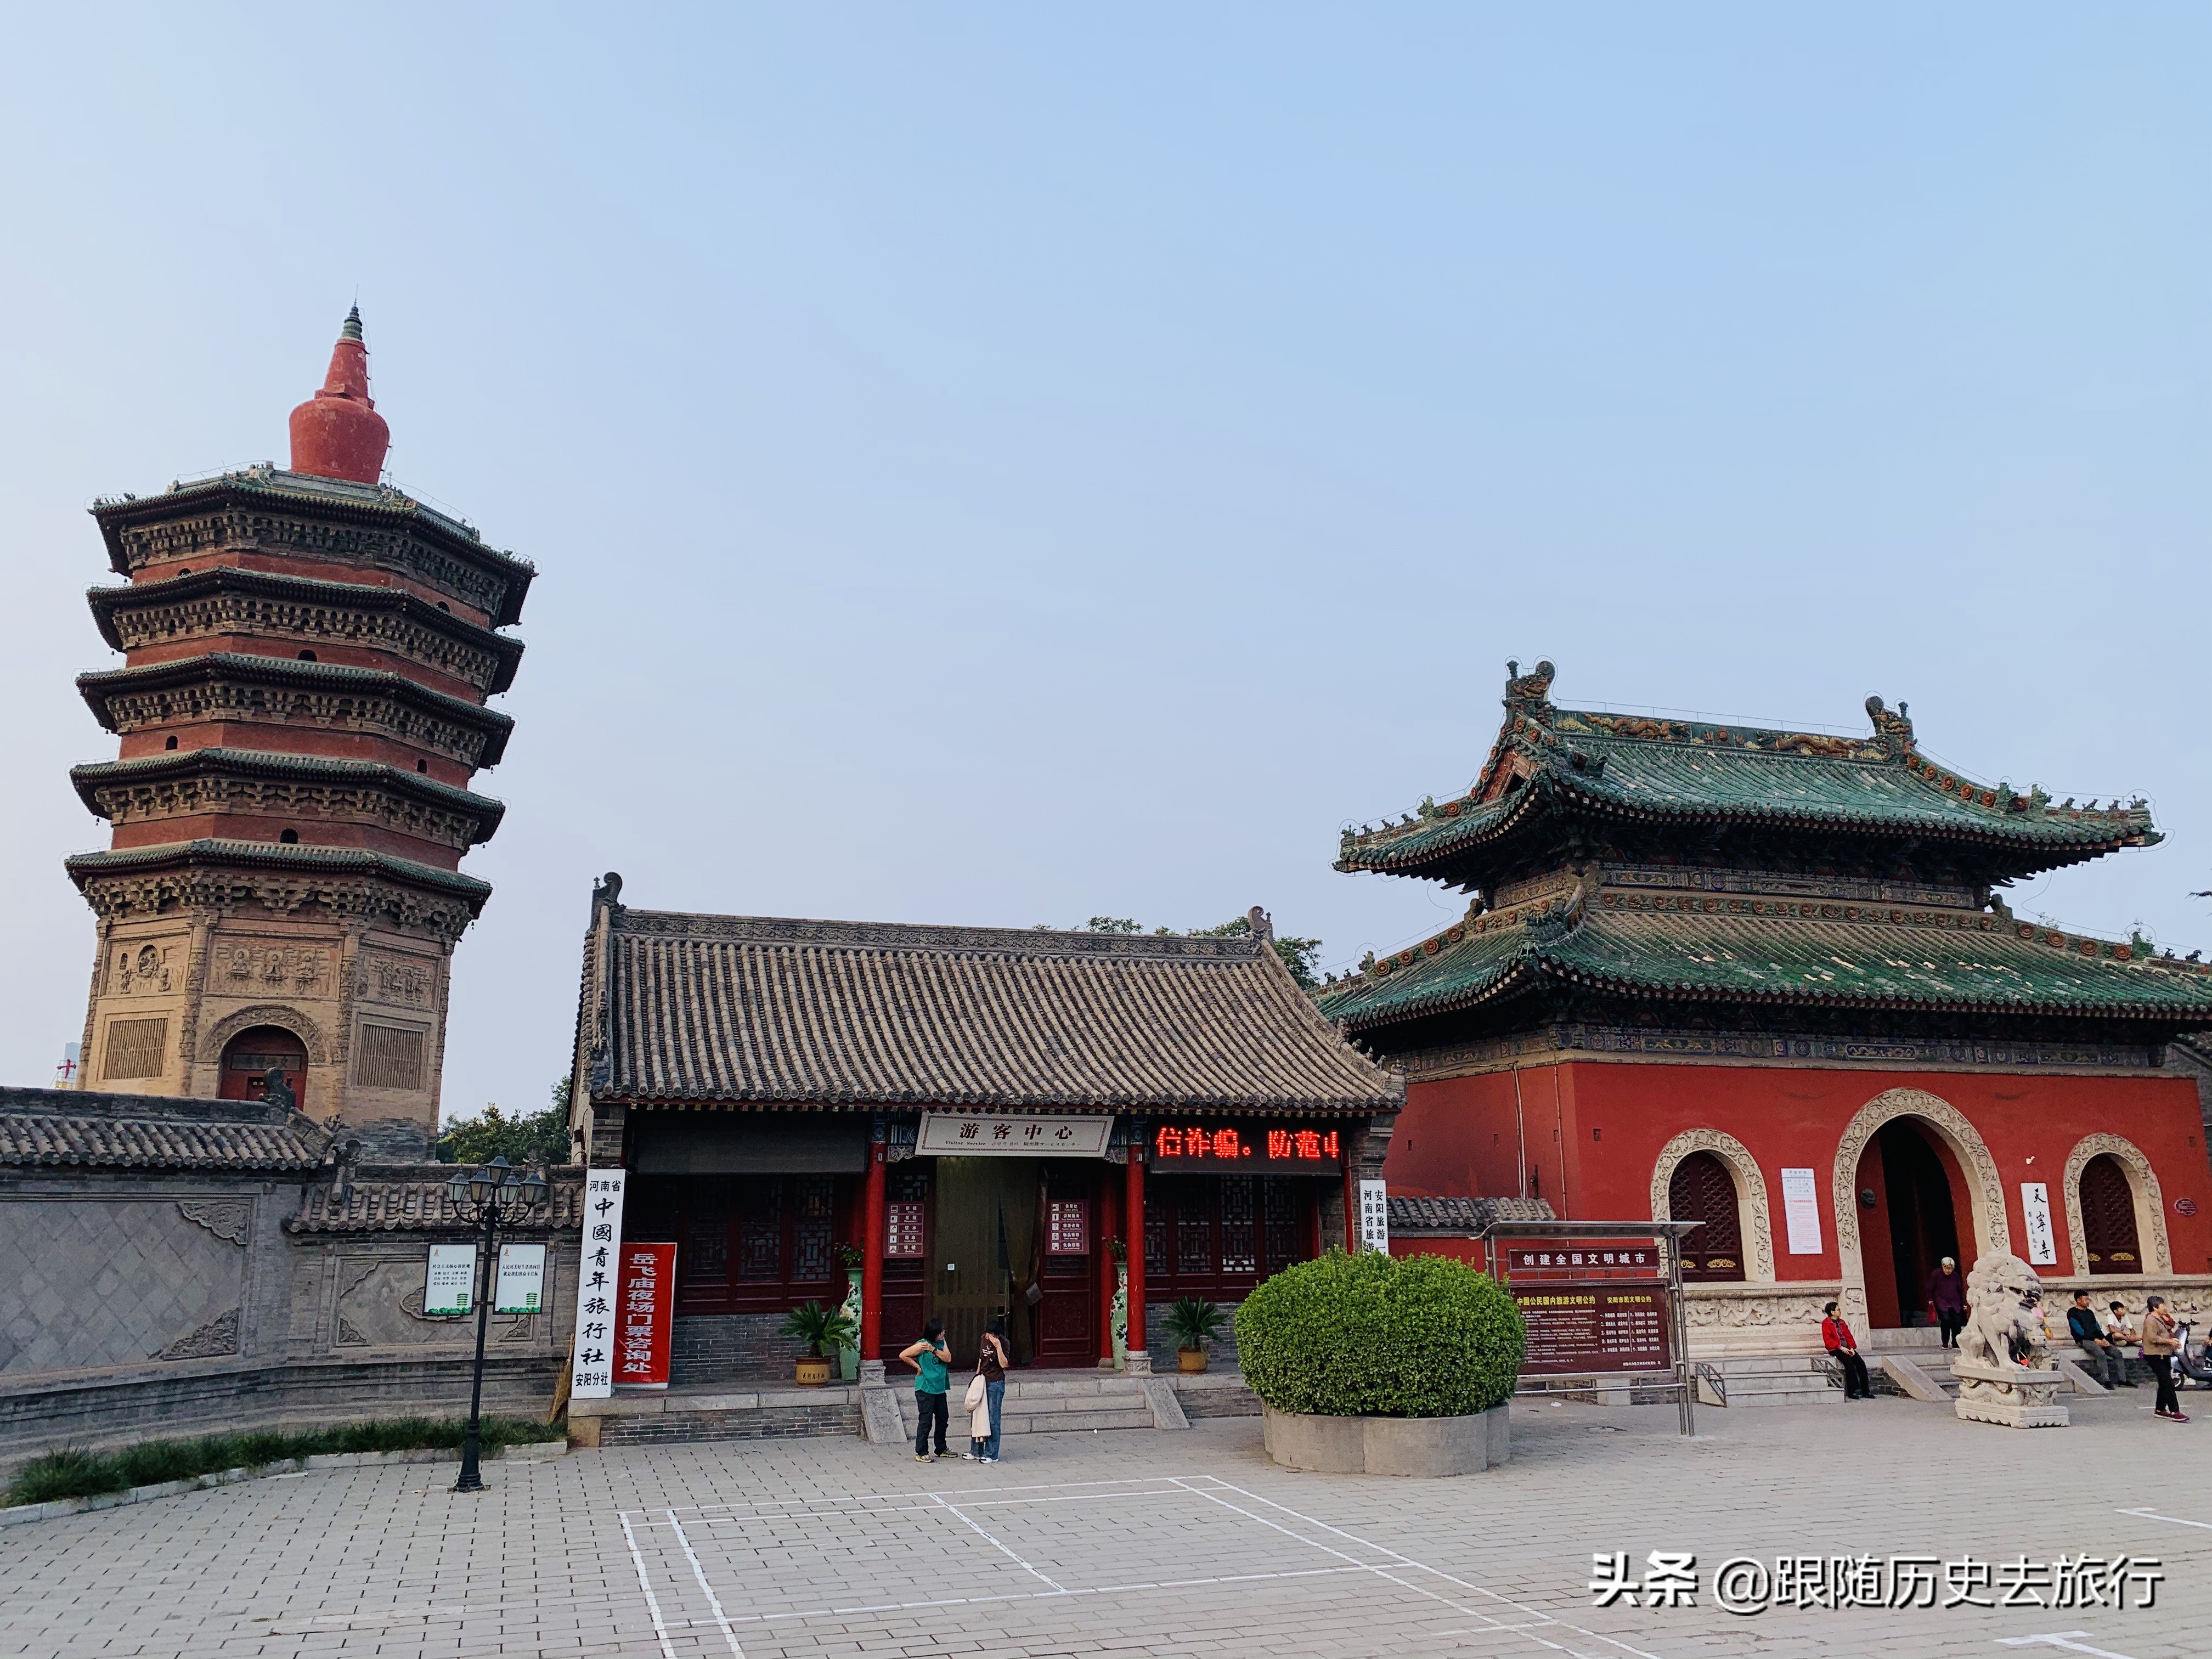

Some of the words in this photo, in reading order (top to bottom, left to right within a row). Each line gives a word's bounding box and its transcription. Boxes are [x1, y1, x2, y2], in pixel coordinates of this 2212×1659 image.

[960, 1122, 1073, 1140] 游客中心
[589, 1180, 622, 1193] 河南省
[1523, 1252, 1645, 1266] 创建全国文明城市
[580, 1198, 614, 1365] 中國青年旅行社
[1517, 1295, 1596, 1306] 中国公民国内旅游文明公约
[1607, 1295, 1652, 1305] 安阳市民文明公约
[622, 1253, 658, 1373] 岳飞庙夜场门票咨询处
[575, 1372, 608, 1387] 安阳分社
